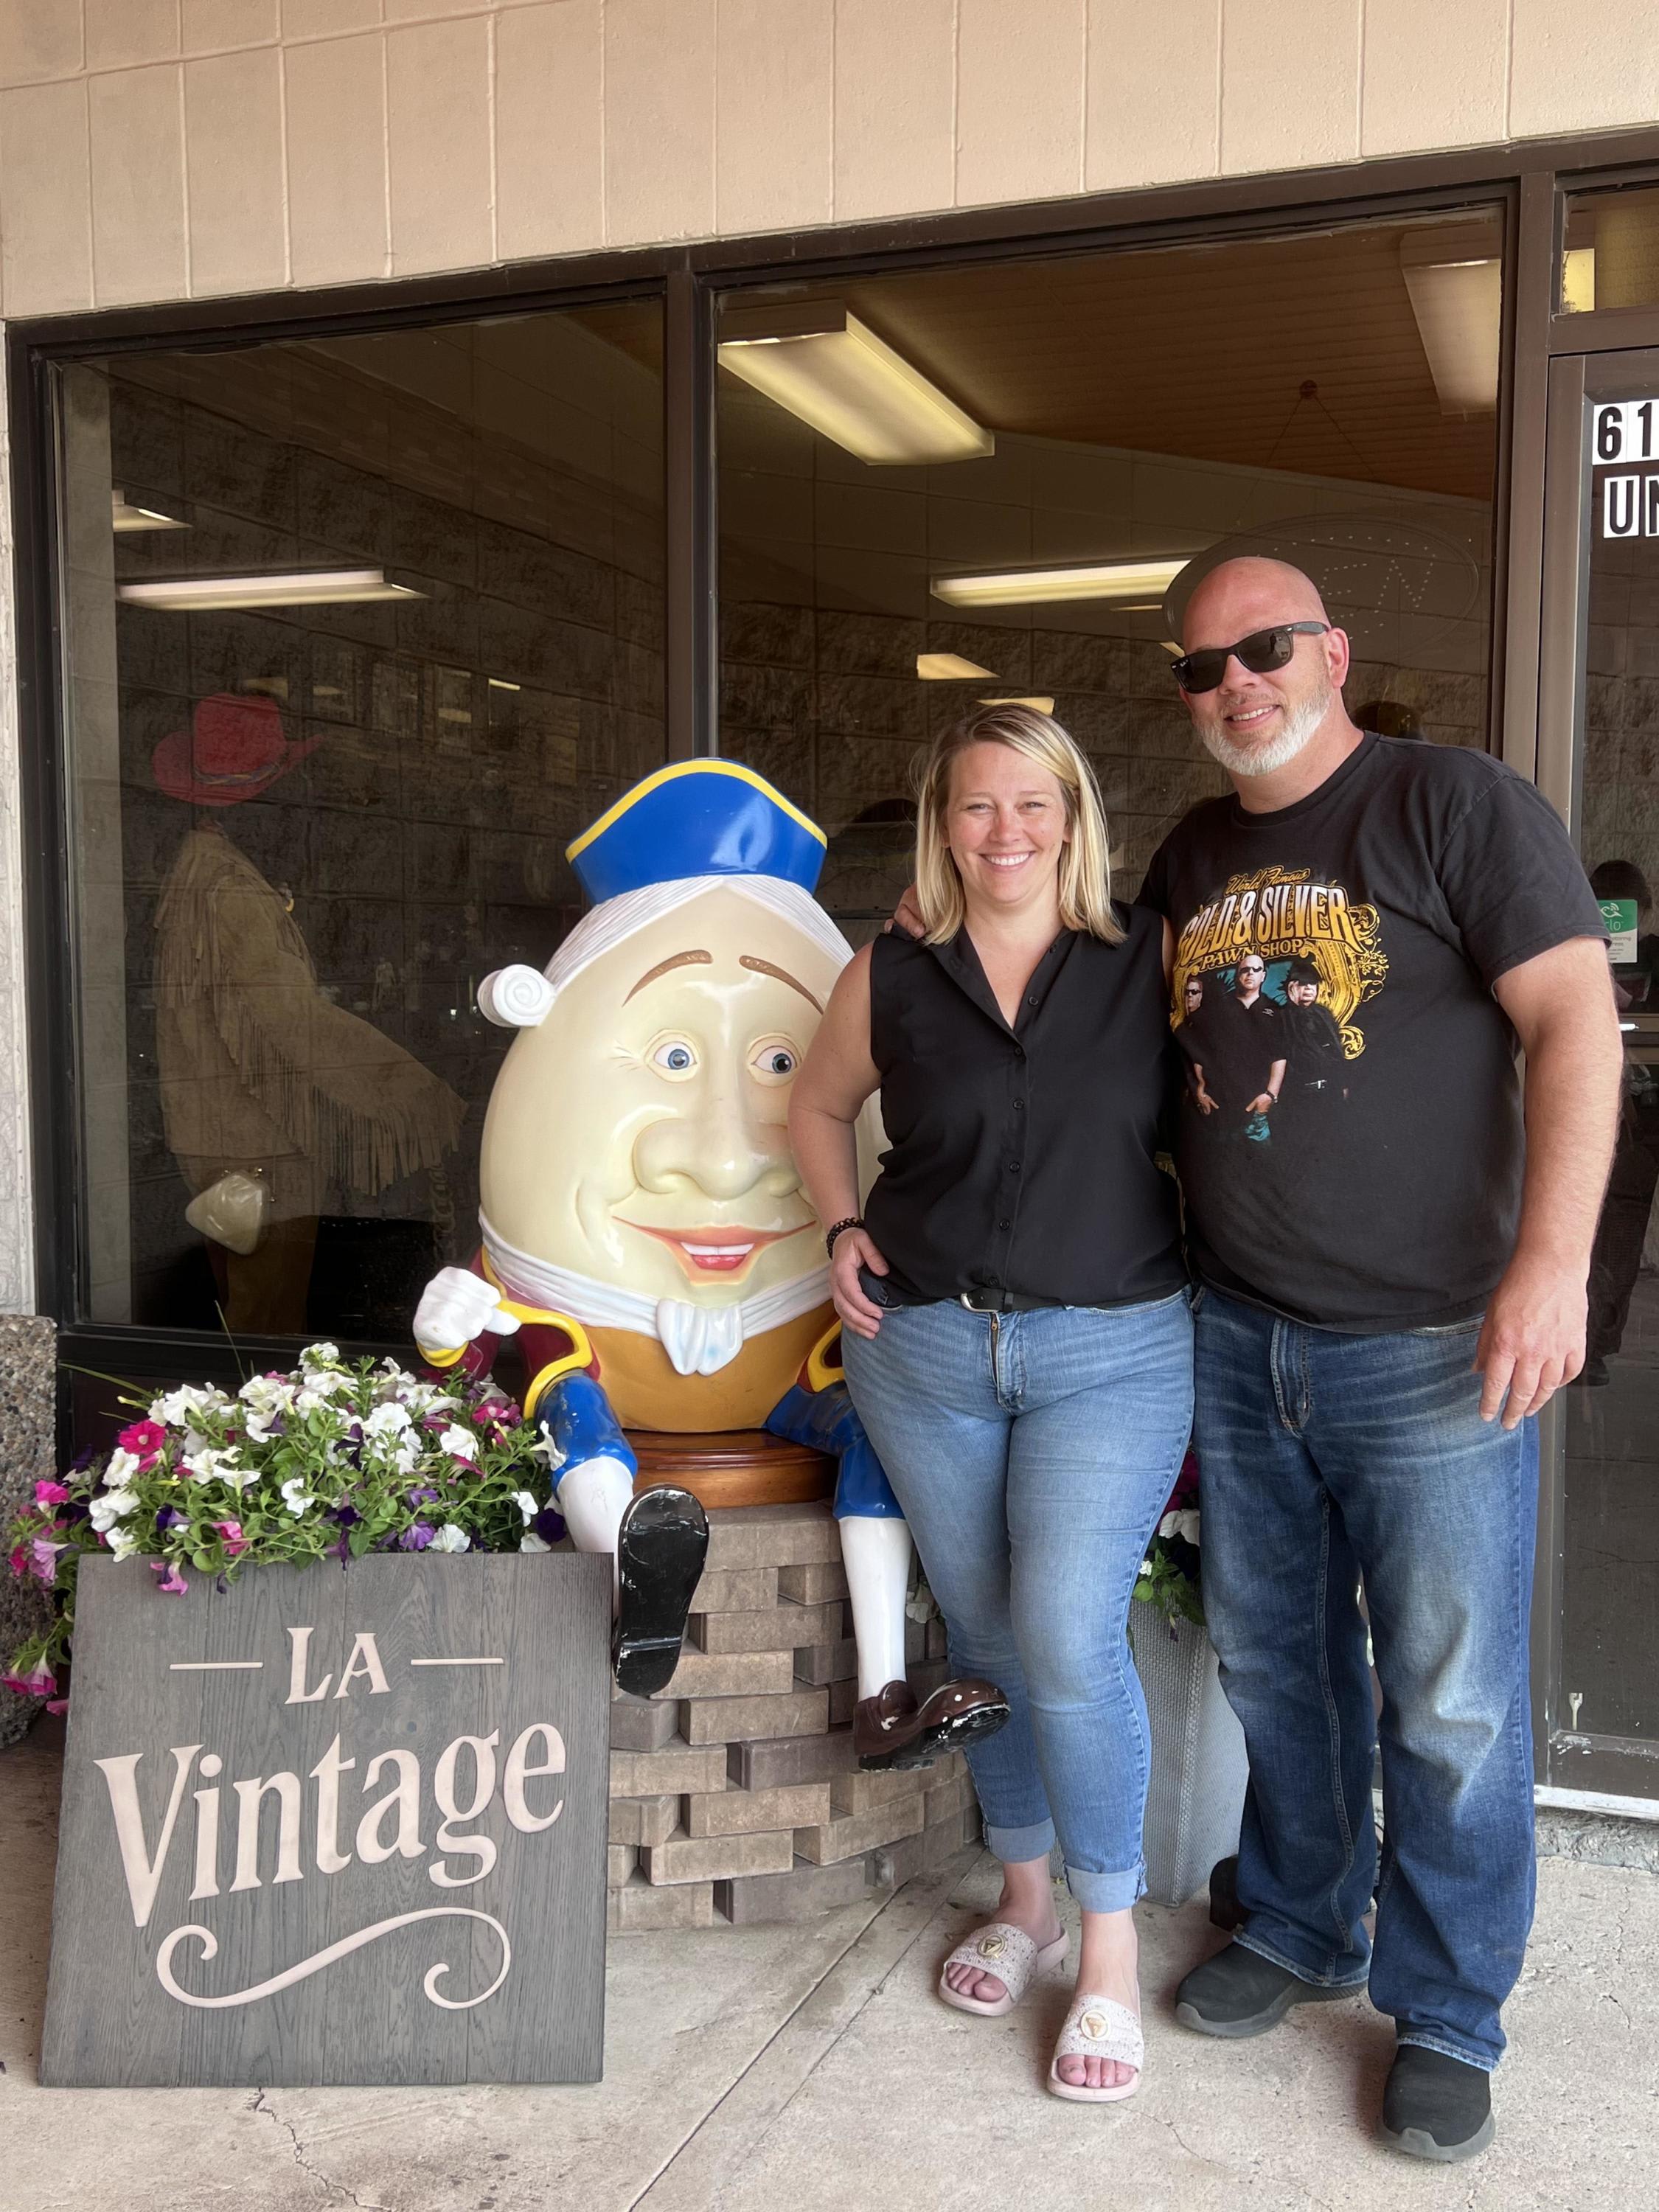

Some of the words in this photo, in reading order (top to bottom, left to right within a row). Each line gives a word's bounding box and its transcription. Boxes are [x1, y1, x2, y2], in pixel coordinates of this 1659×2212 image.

[1597, 402, 1652, 461] 61
[1225, 869, 1267, 894] World
[1266, 867, 1309, 886] Famous
[1179, 894, 1237, 967] GOLD
[1232, 891, 1257, 946] &
[1256, 885, 1366, 954] SILVER
[1200, 946, 1256, 970] PAWN
[1260, 939, 1304, 957] SHOP
[1604, 919, 1621, 931] rlo
[284, 1627, 392, 1705] LA
[93, 1722, 566, 1927] Vintage
